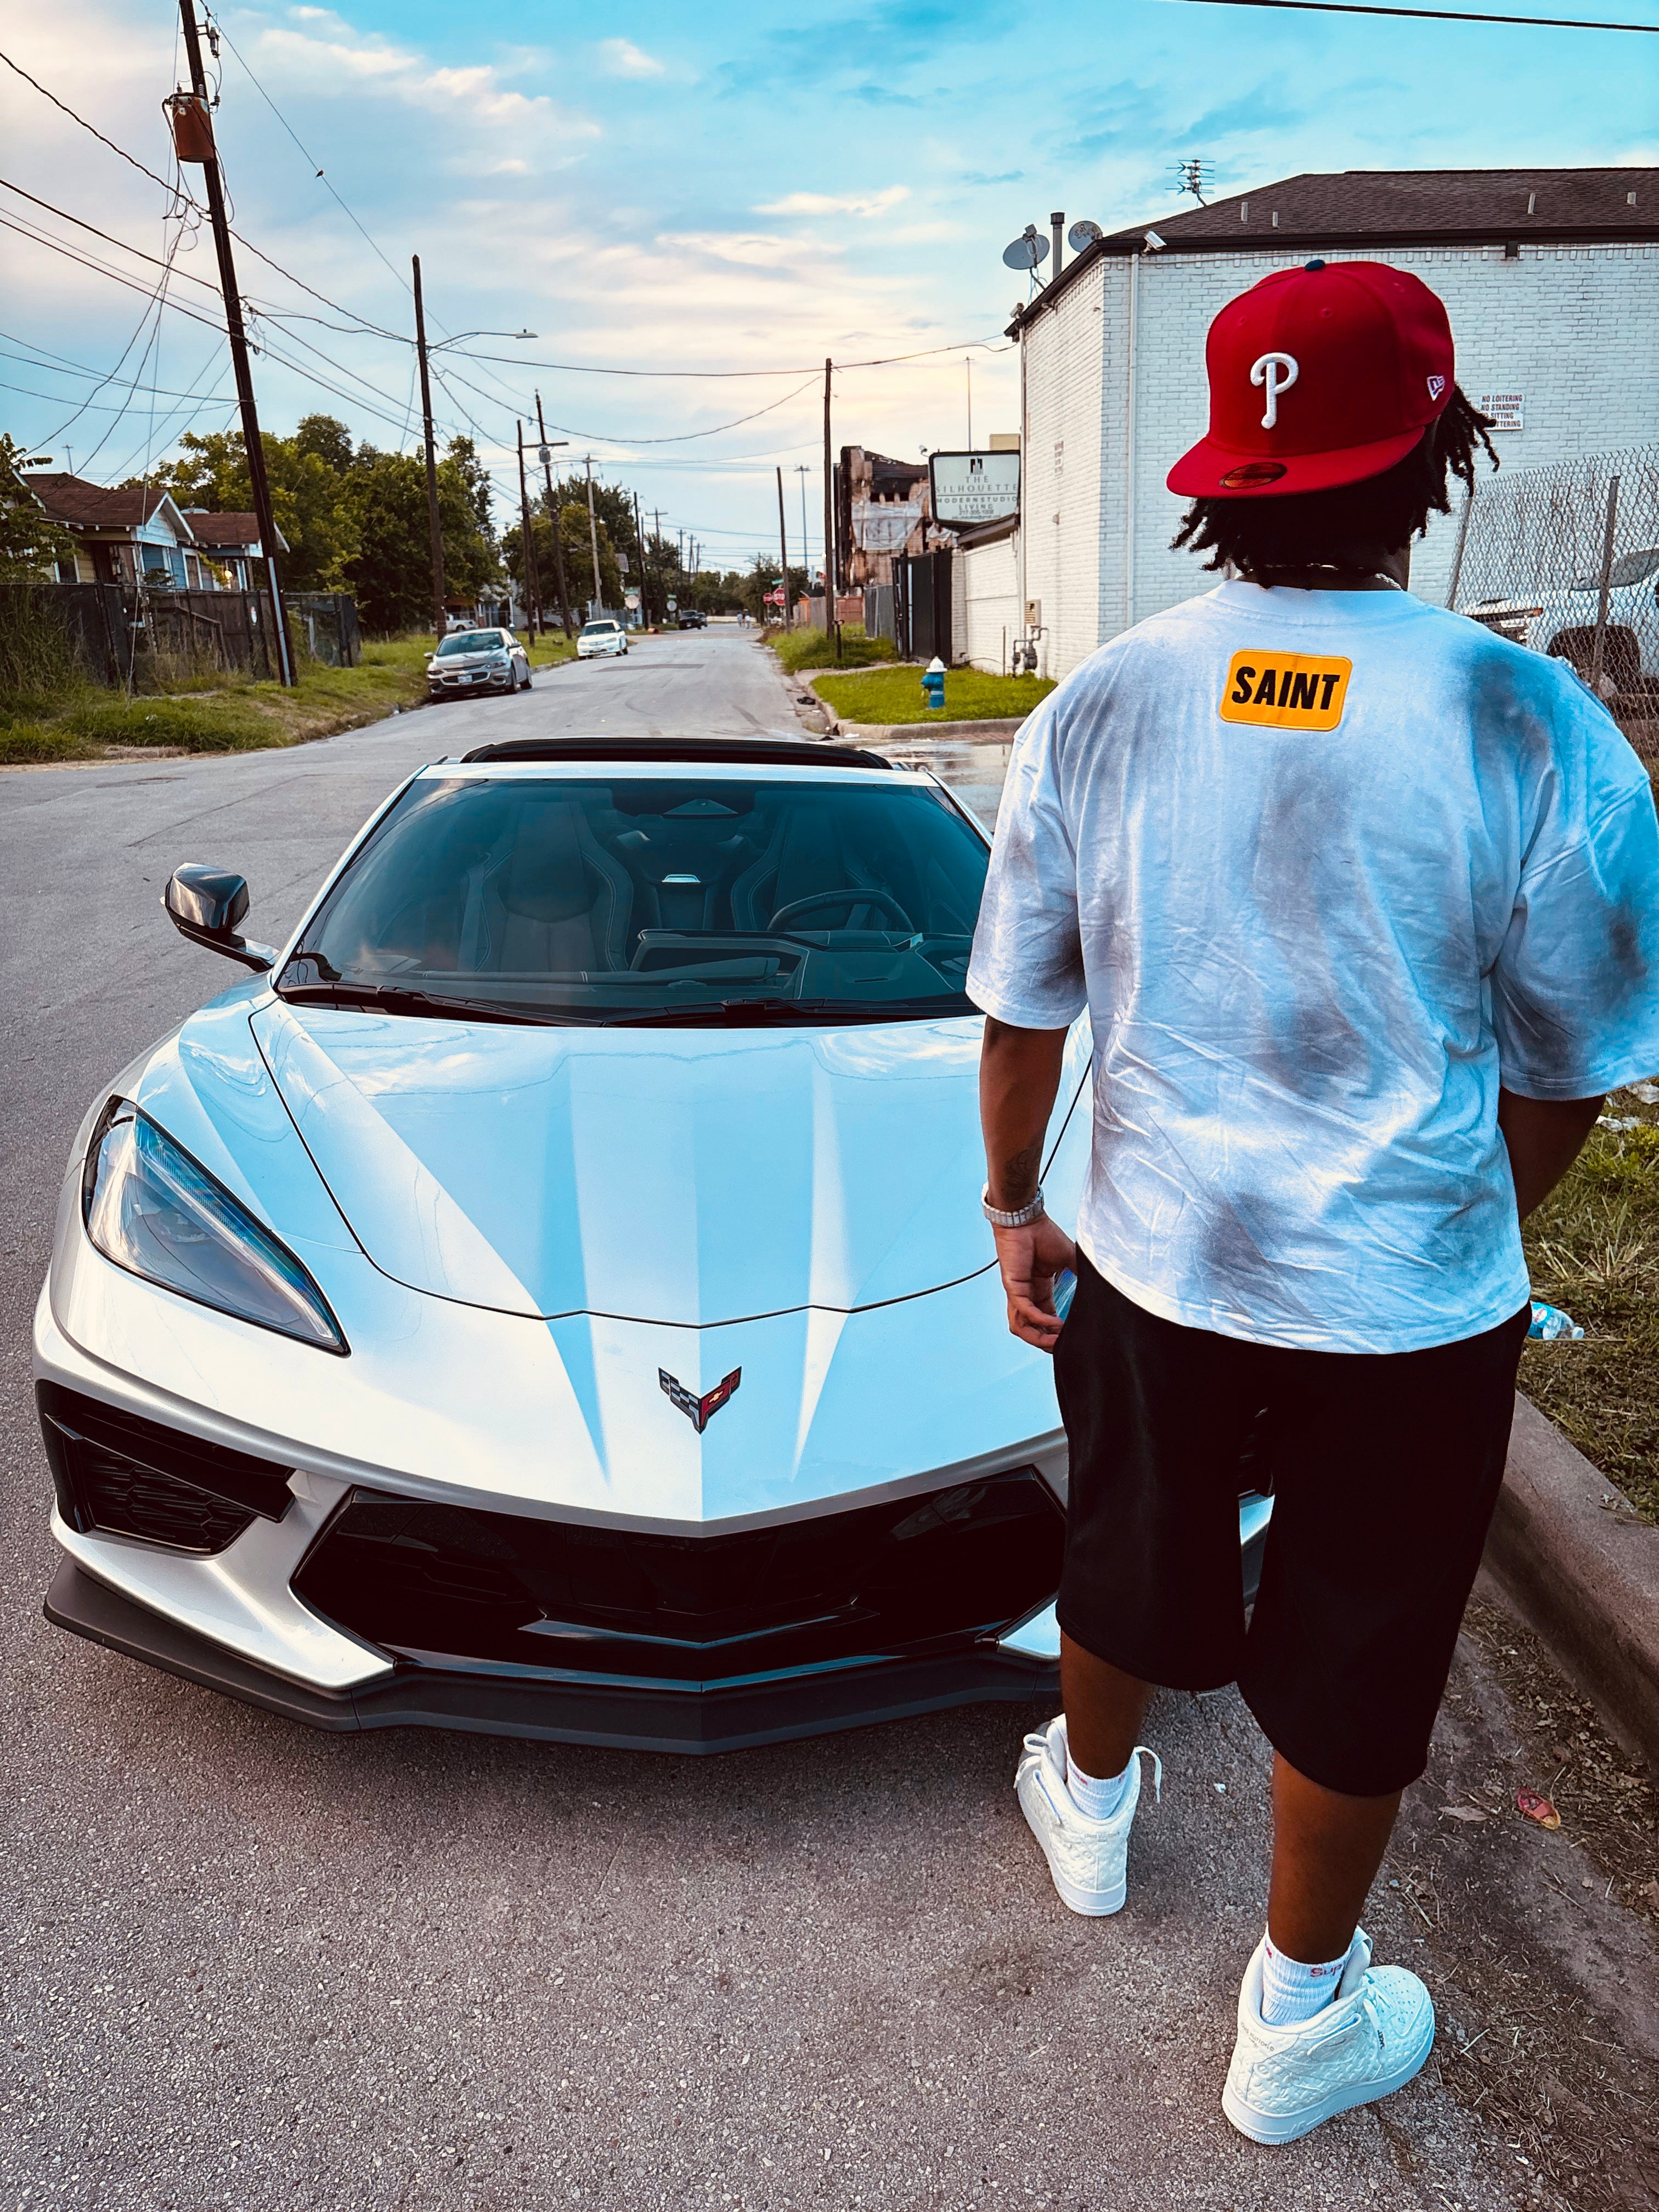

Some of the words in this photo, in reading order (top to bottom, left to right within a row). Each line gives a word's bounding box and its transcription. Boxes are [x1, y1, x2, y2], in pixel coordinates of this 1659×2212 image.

[1250, 352, 1299, 430] P
[935, 484, 1017, 493] SILHOUETTE
[1232, 666, 1341, 710] SAINT
